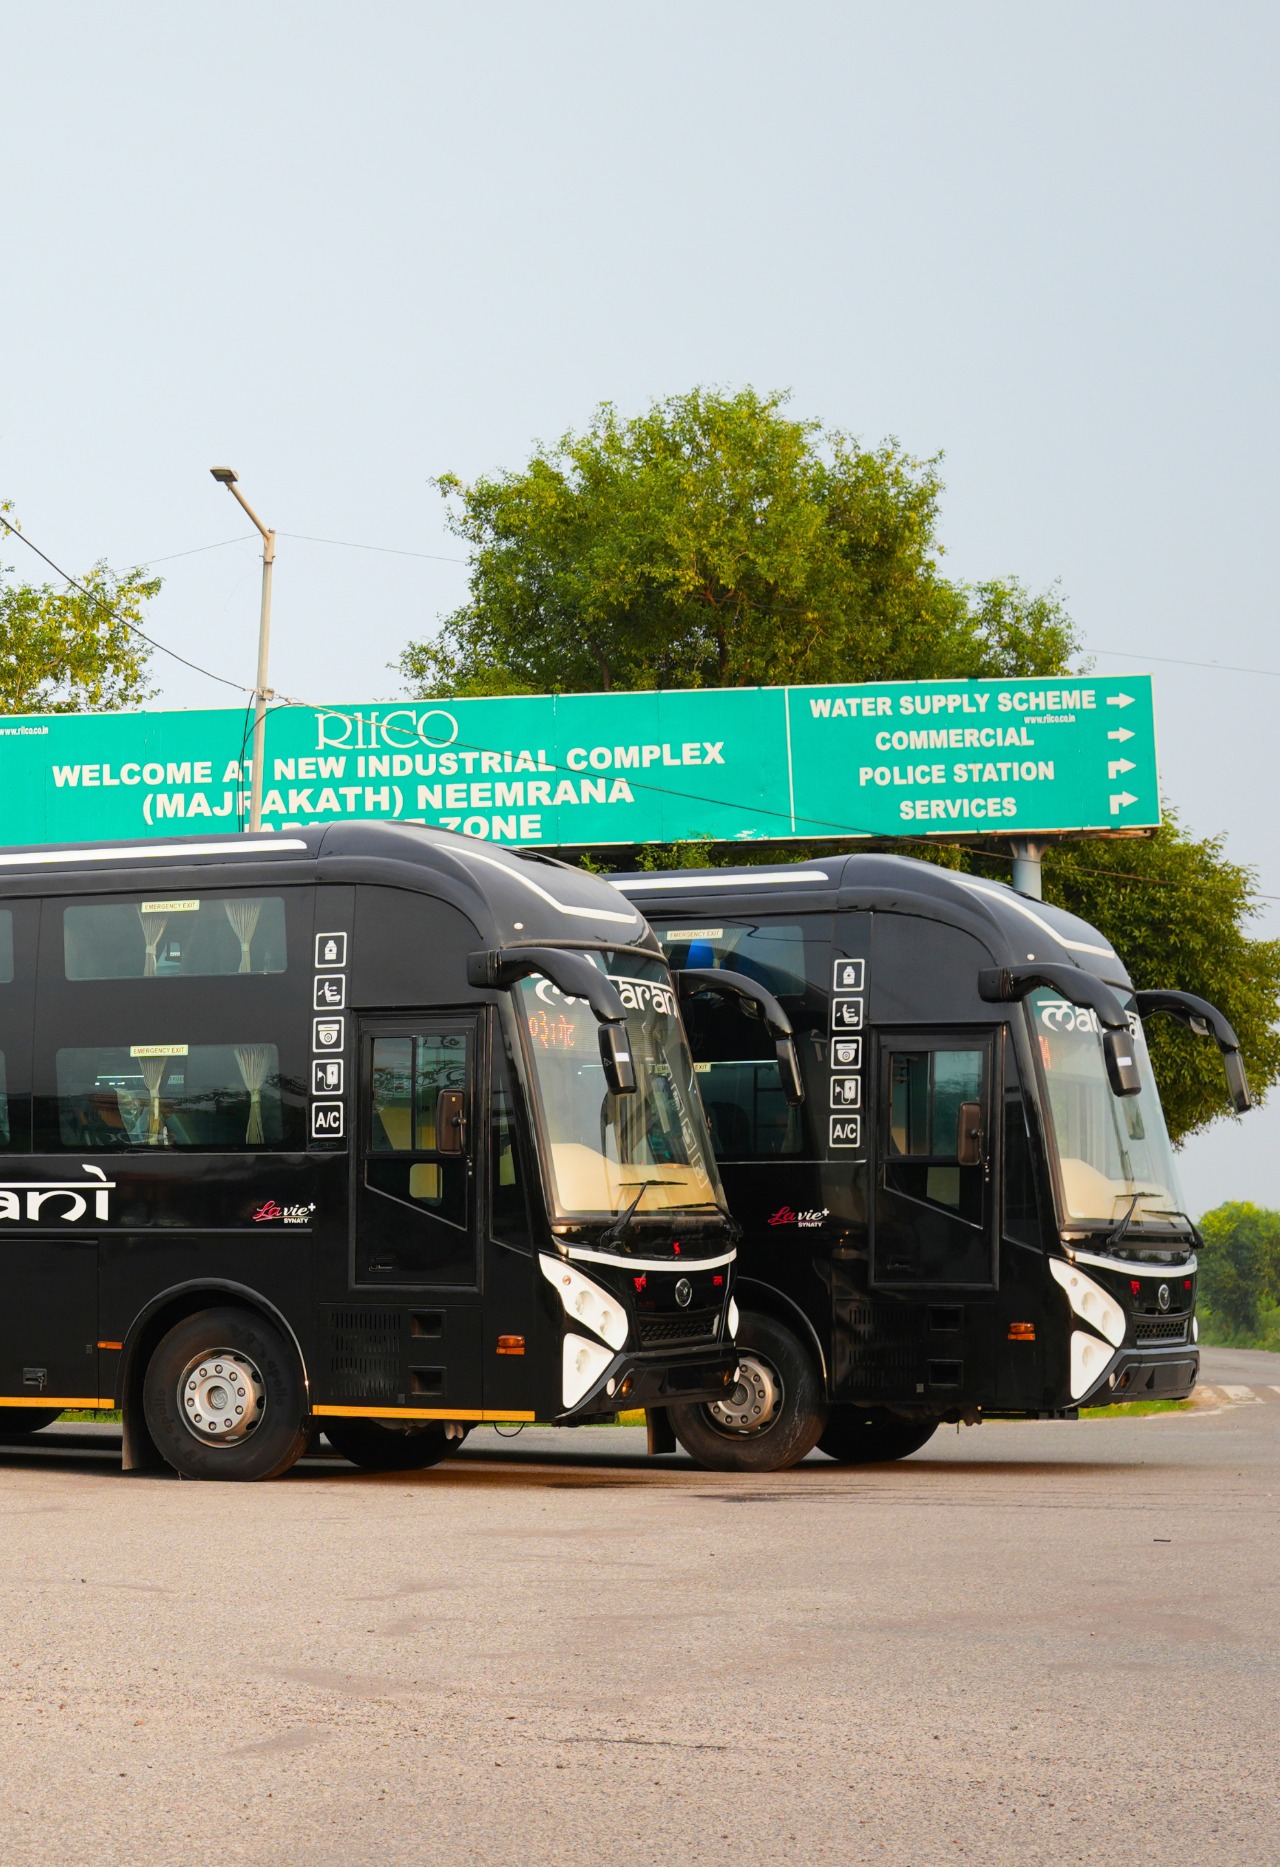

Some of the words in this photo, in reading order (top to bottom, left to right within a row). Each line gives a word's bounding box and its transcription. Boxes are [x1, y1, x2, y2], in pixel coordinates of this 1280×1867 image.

[809, 698, 893, 718] WATER
[899, 693, 990, 716] SUPPLY
[997, 689, 1097, 712] SCHEME
[875, 727, 1035, 751] COMMERCIAL
[52, 761, 213, 788] WELCOME
[222, 760, 254, 784] AT
[274, 756, 347, 781] NEW
[357, 749, 557, 778] INDUSTRIAL
[566, 741, 725, 771] COMPLEX
[859, 766, 946, 786] POLICE
[953, 761, 1055, 783] STATION
[417, 777, 635, 810] NEEMRANA
[899, 797, 1017, 820] SERVICES
[447, 814, 542, 839] ZONE
[144, 902, 182, 911] EMERGENCY
[669, 930, 706, 938] EMERGENCY
[133, 1047, 171, 1055] EMERGENCY
[315, 1111, 340, 1128] A/C
[833, 1123, 857, 1139] A/C
